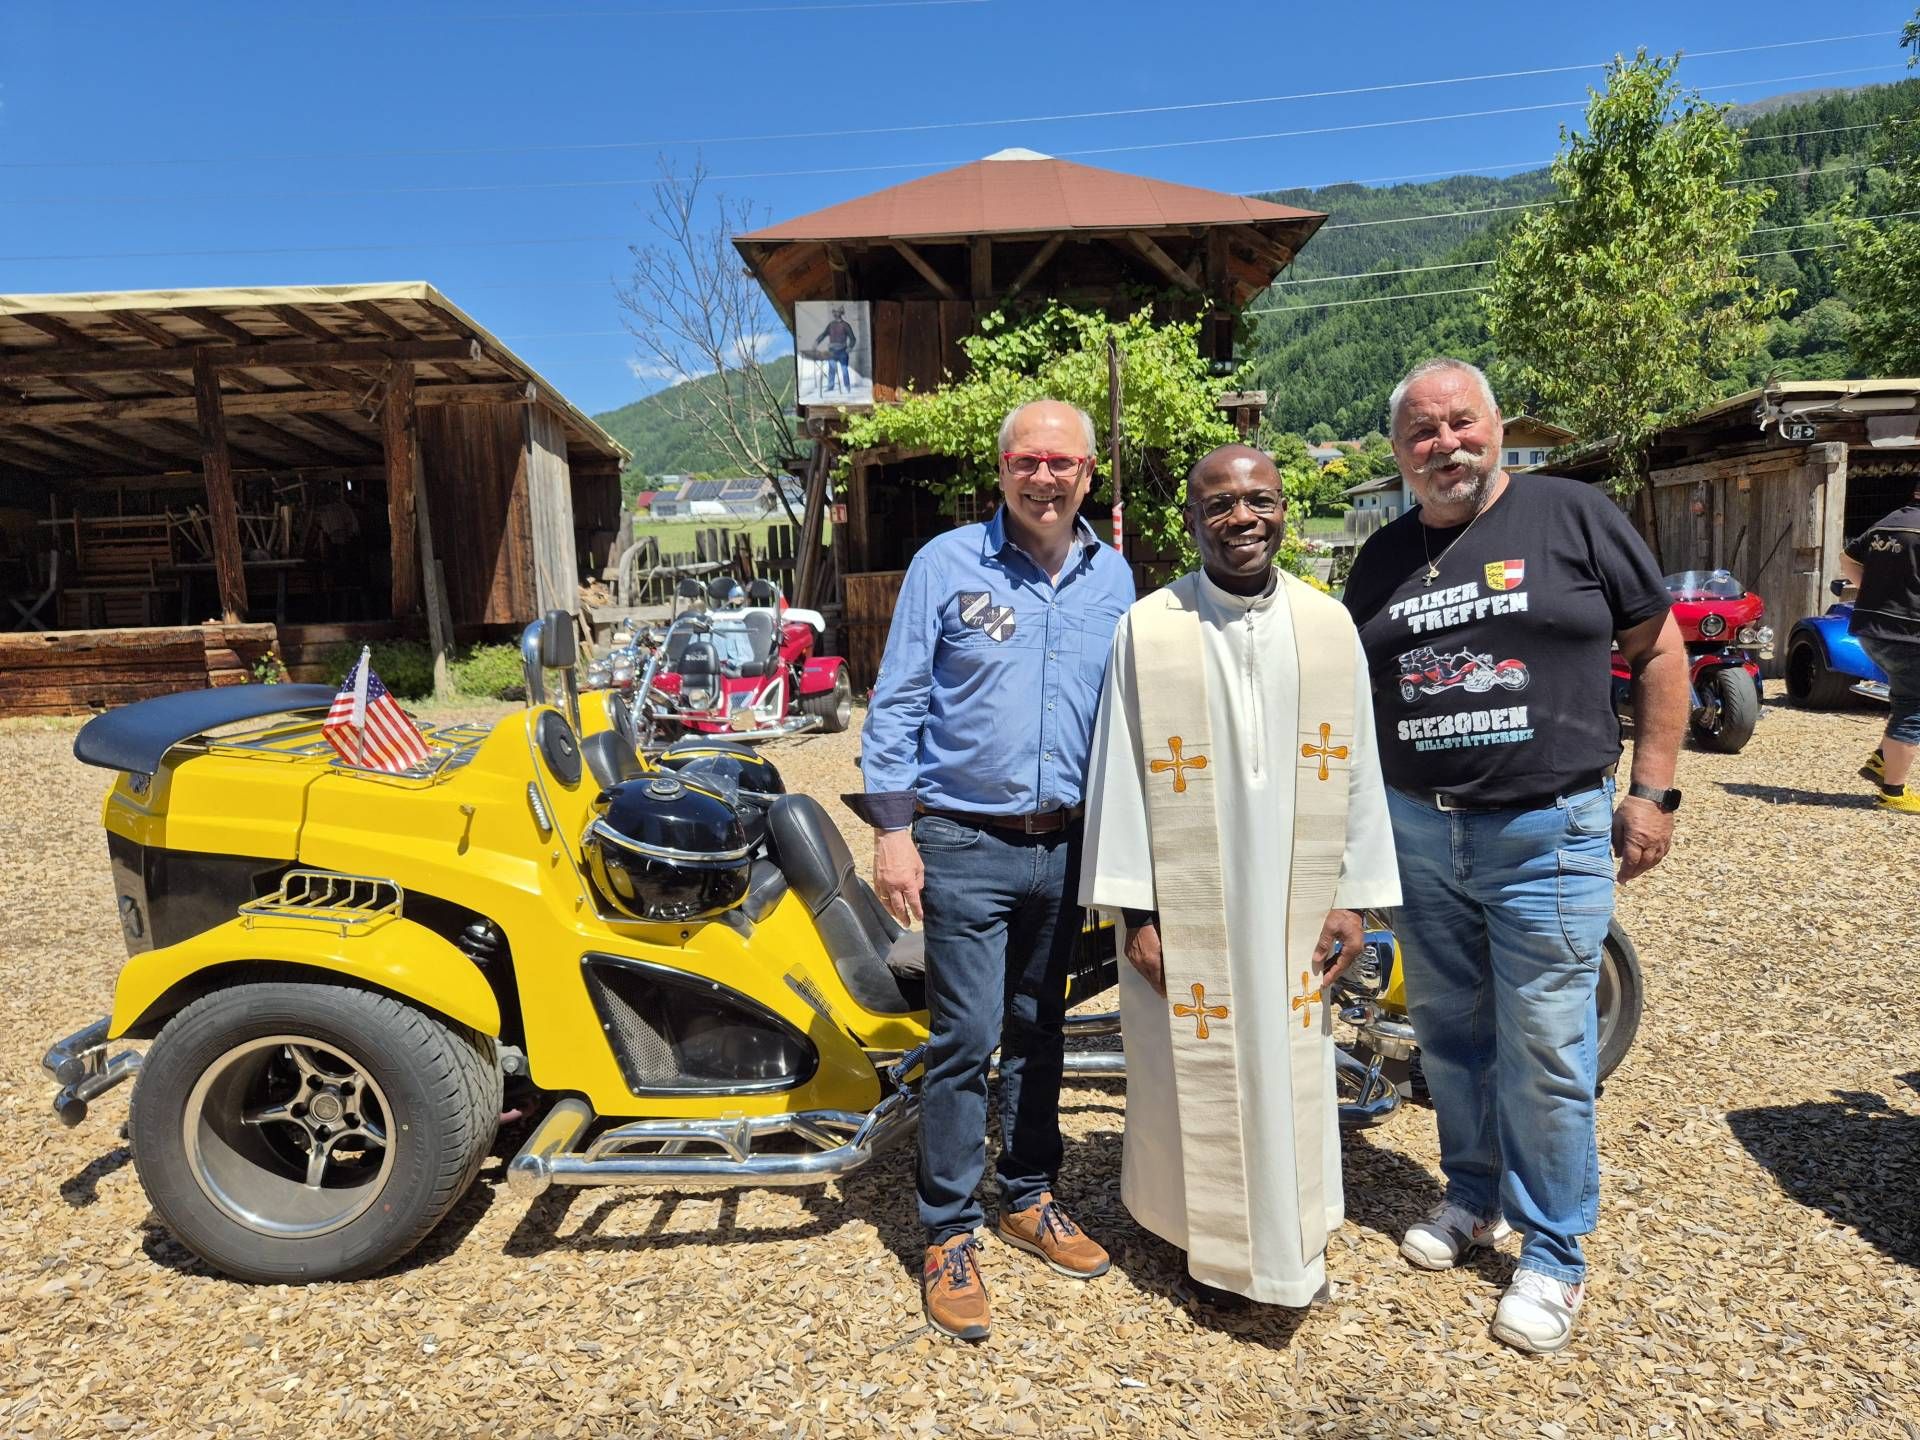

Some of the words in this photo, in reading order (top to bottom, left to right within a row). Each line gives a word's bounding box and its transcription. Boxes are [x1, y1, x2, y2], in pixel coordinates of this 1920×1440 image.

[1388, 581, 1480, 620] TRIKER
[1407, 591, 1529, 635] TREFFEN
[1397, 705, 1528, 741] SEEBODEN
